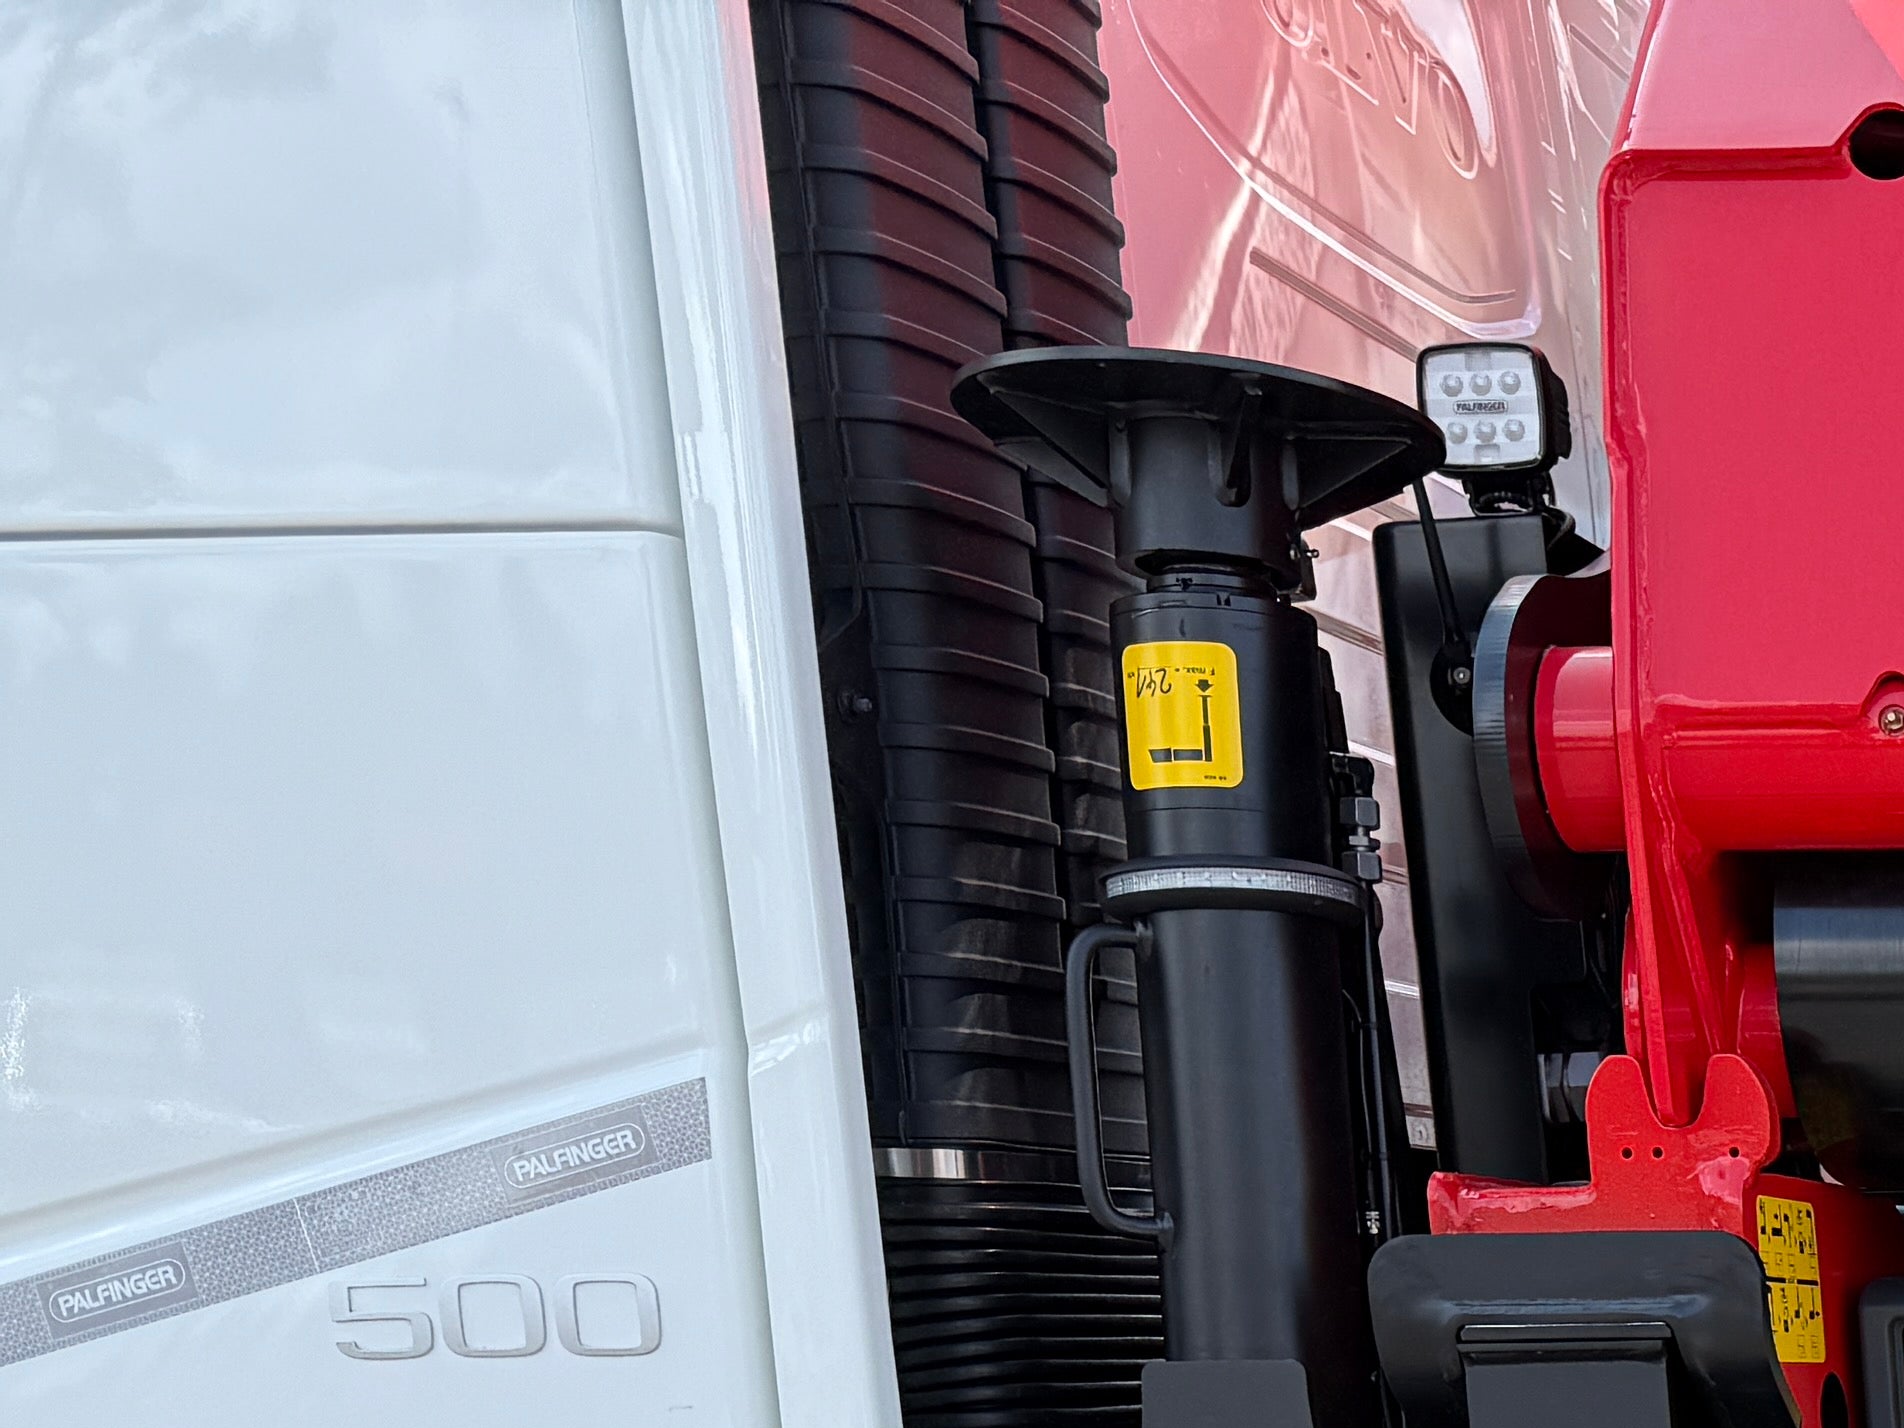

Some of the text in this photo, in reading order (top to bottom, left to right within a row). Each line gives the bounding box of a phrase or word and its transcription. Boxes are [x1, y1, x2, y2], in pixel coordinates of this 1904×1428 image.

[513, 1129, 637, 1184] PALFINGER
[58, 1262, 177, 1316] PALFINGER
[329, 1273, 663, 1362] 500
